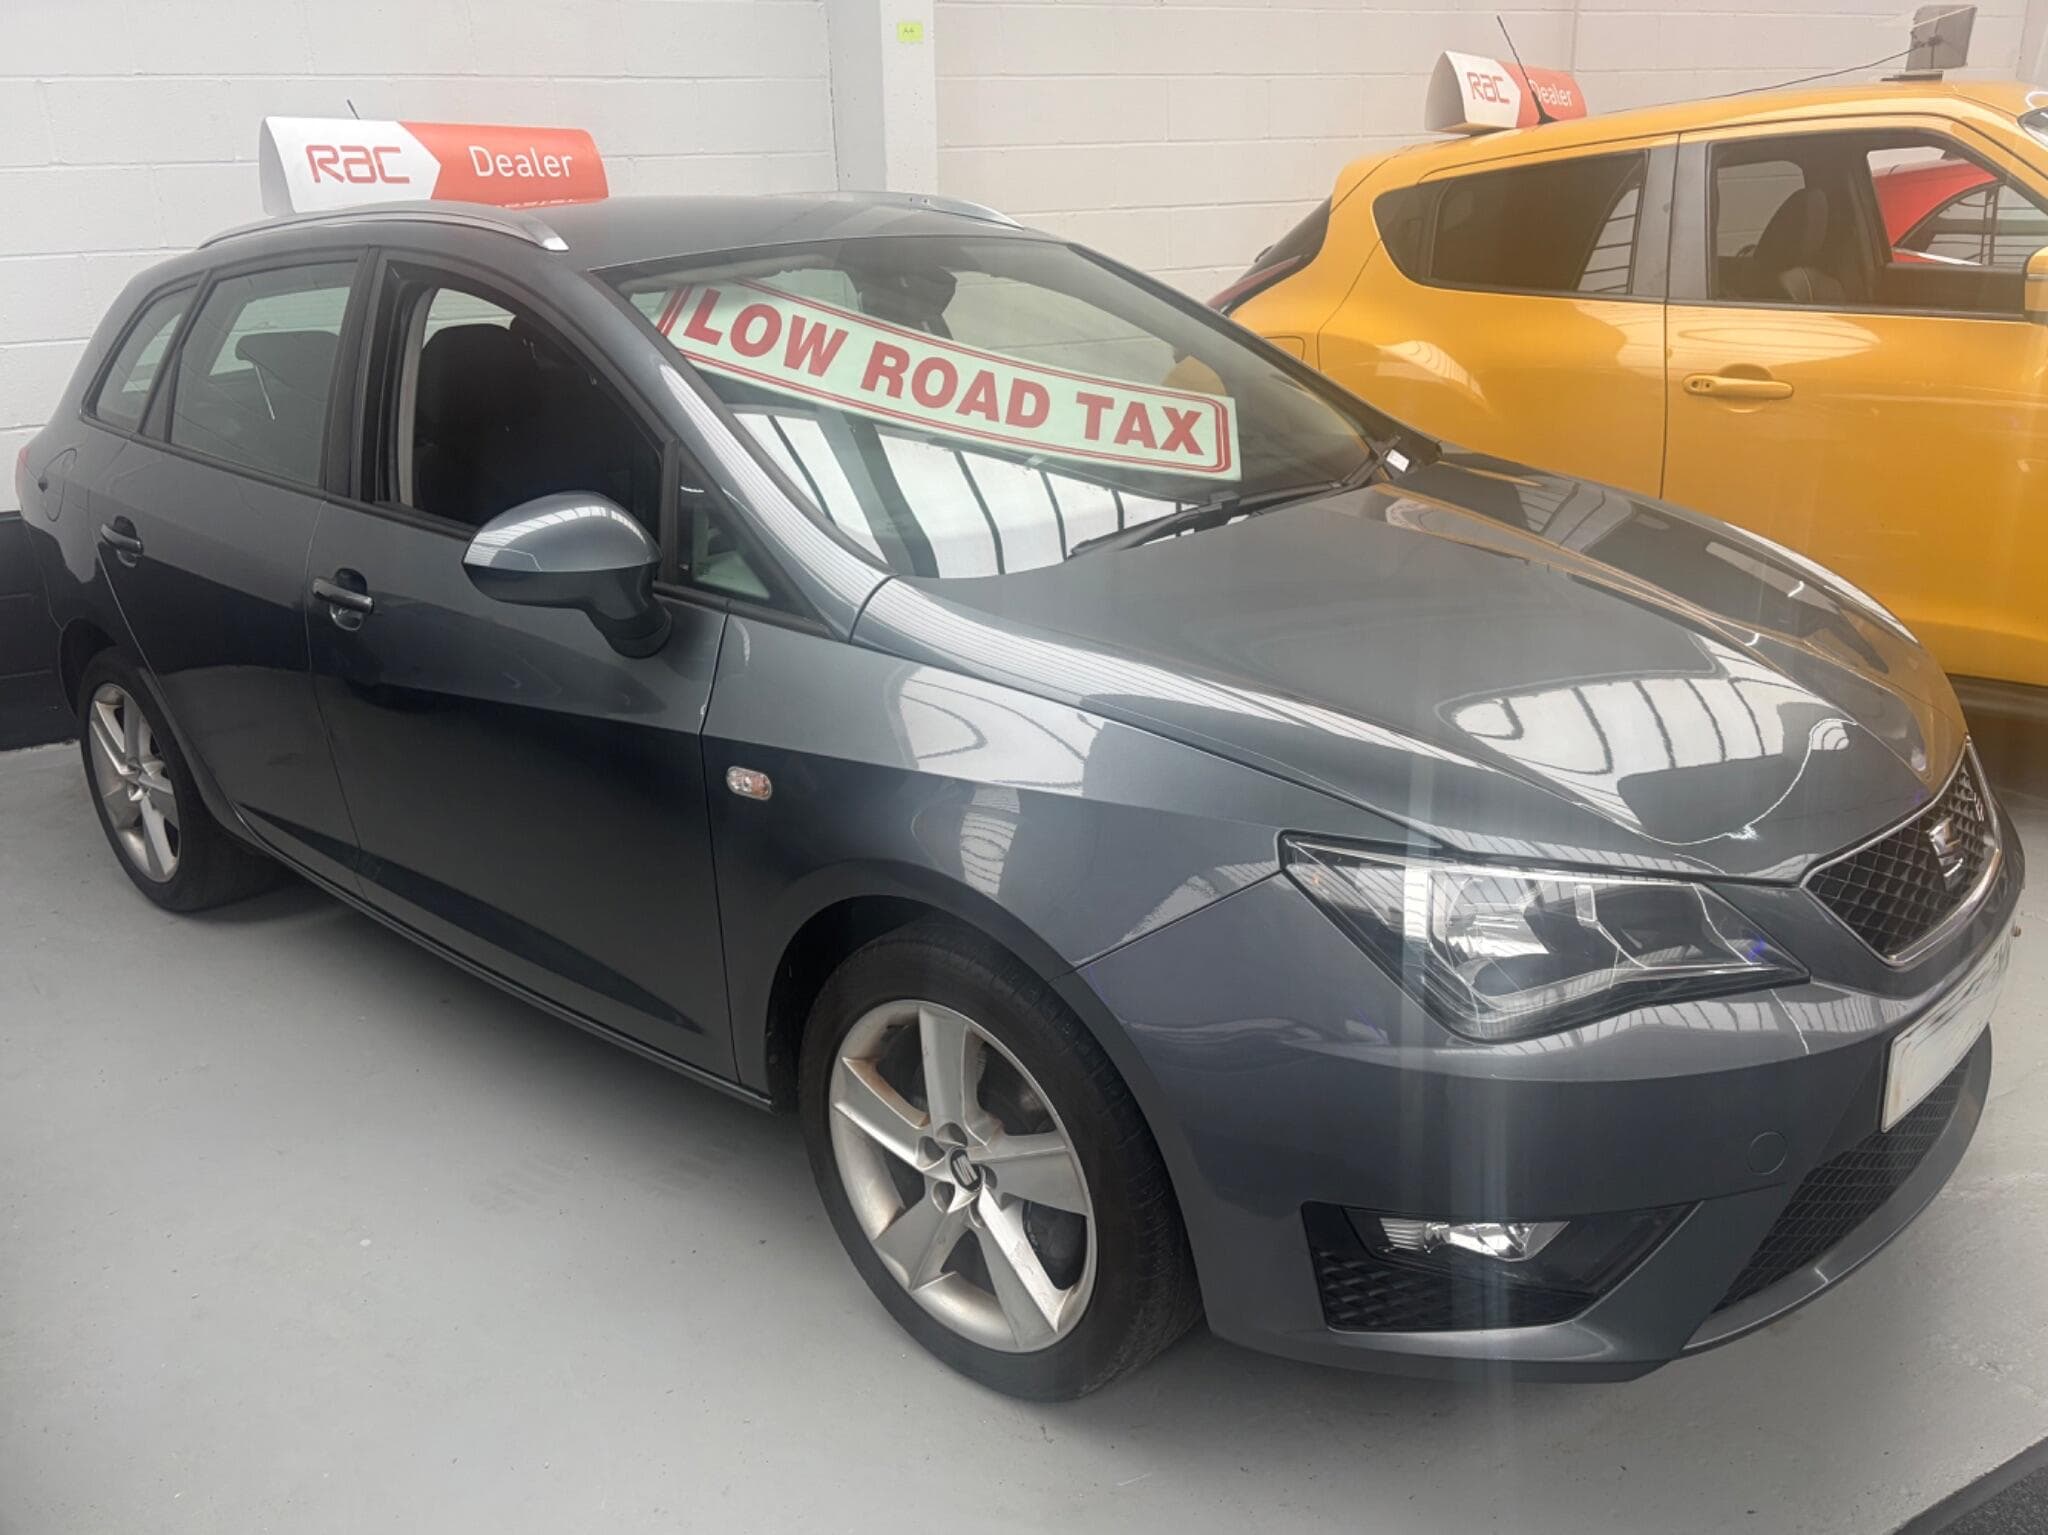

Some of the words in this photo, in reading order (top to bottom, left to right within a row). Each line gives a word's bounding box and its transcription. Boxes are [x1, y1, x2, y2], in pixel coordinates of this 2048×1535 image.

[467, 144, 573, 179] Dealer
[682, 287, 849, 377] LOW
[860, 340, 1051, 430] ROAD
[1075, 392, 1205, 458] TAX
